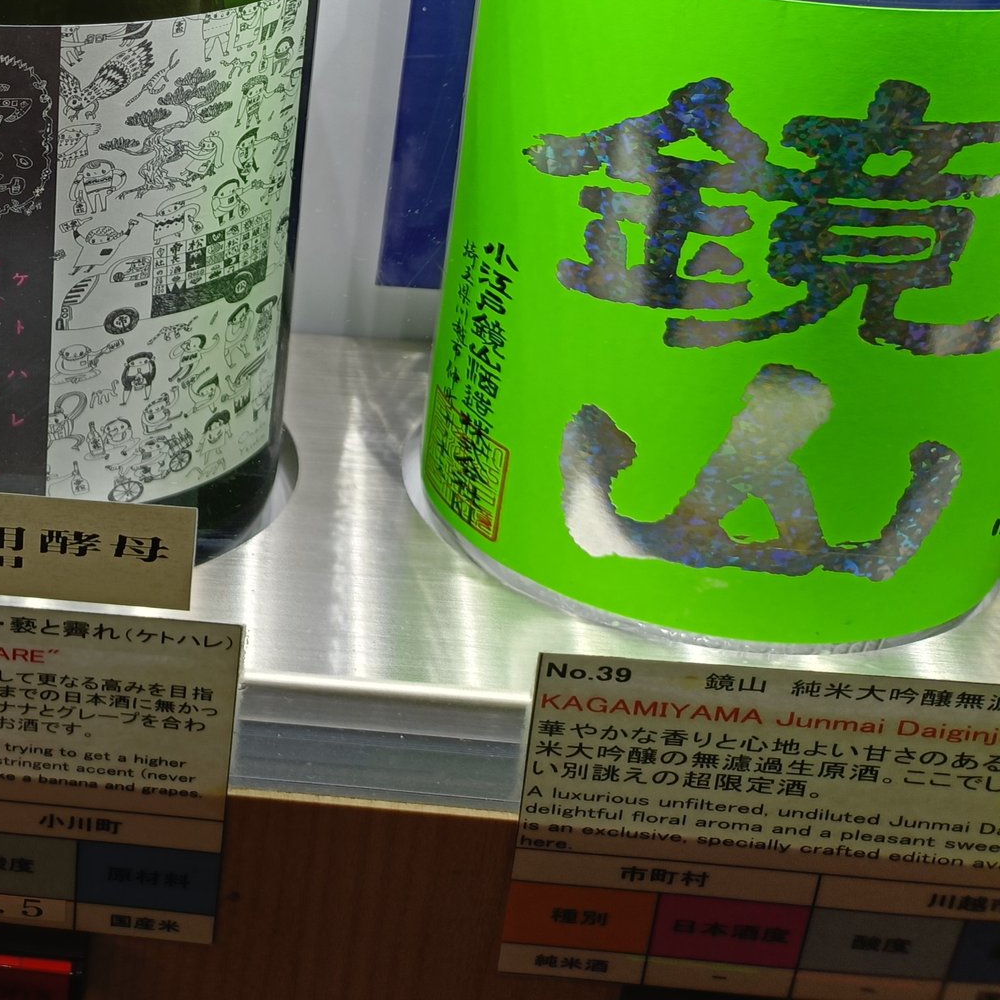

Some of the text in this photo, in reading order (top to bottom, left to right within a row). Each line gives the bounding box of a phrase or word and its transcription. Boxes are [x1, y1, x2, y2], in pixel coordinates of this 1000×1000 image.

[523, 76, 1000, 582] 鏡山
[546, 661, 633, 683] No.39
[705, 672, 768, 694] 鏡山
[541, 693, 763, 724] KAGAMIYAMA
[775, 711, 886, 735] Junmai
[5, 742, 53, 758] trying
[60, 747, 78, 758] to
[84, 751, 111, 764] get
[117, 753, 128, 763] a
[134, 753, 188, 770] higher
[22, 773, 33, 783] a
[38, 773, 98, 789] banana
[104, 780, 136, 793] and
[141, 785, 204, 801] grapes.
[75, 763, 135, 778] accent
[140, 768, 197, 784] (never
[532, 760, 820, 799] い別誂えの超限定酒。
[527, 785, 543, 797] A
[552, 786, 649, 806] luxurious
[658, 797, 769, 817] unfiltered,
[778, 808, 881, 826] undiluted
[889, 815, 971, 833] Junmai
[39, 813, 123, 835] 小川町
[525, 802, 623, 820] delightful
[632, 810, 687, 826] floral
[695, 819, 764, 833] aroma
[772, 825, 812, 837] and
[819, 829, 831, 839] a
[840, 829, 936, 848] pleasant
[522, 818, 540, 831] is
[548, 823, 573, 833] an
[581, 825, 687, 845] exclusive,
[696, 834, 792, 853] specially
[799, 844, 881, 860] crafted
[888, 851, 964, 867] edition
[106, 866, 192, 889] 原材料
[620, 866, 710, 888] 市町村
[110, 913, 181, 933] 国産米
[551, 906, 609, 926] 種別
[672, 919, 791, 945] 日本酒度
[851, 934, 912, 955] 酸度
[534, 953, 609, 974] 純米酒
